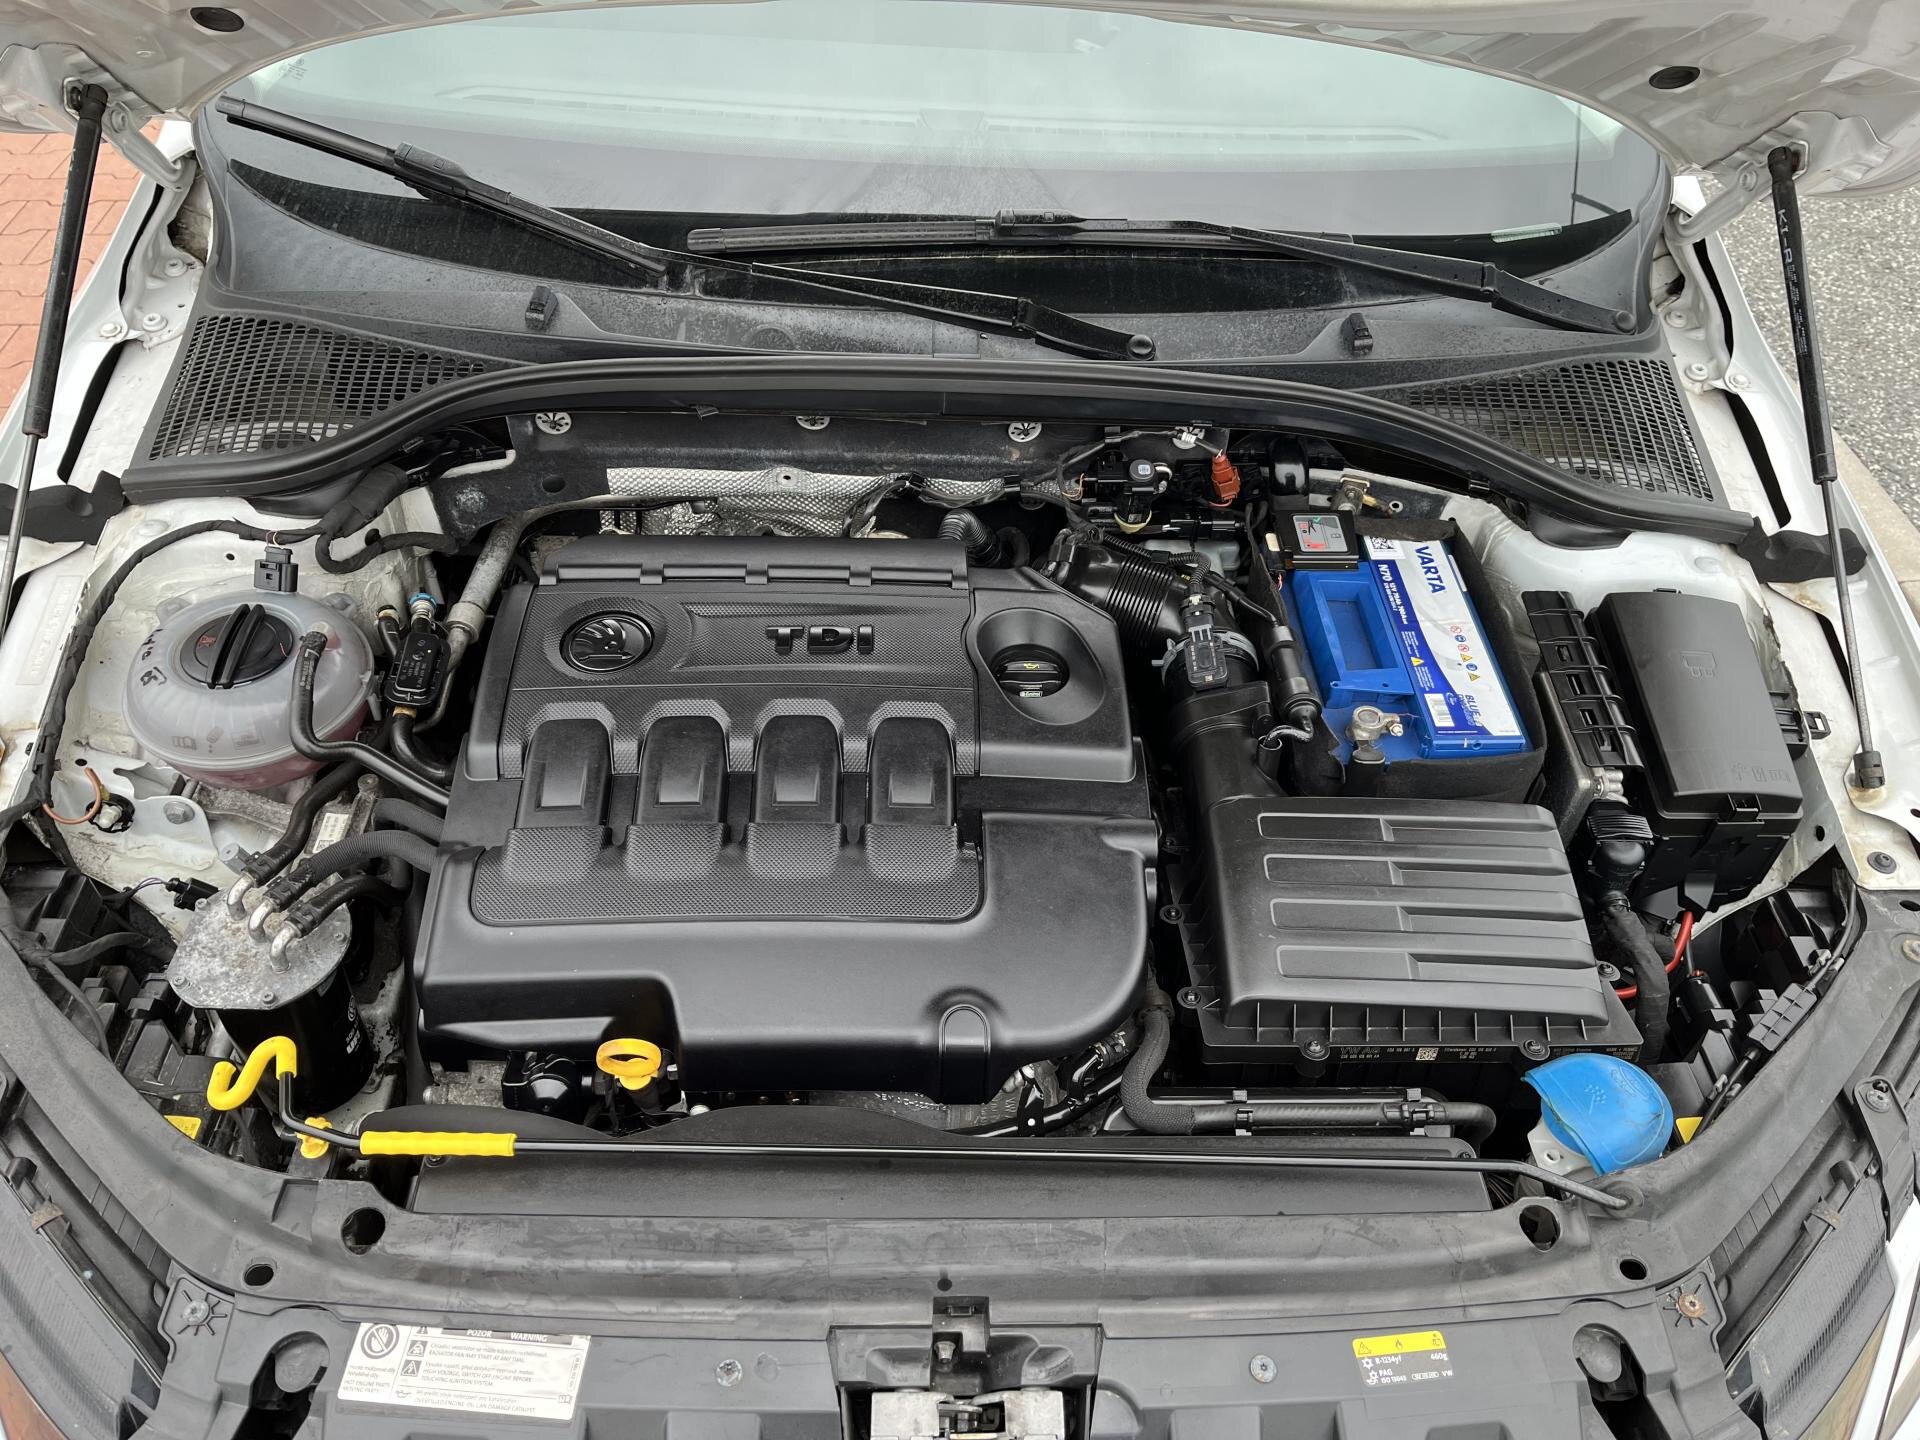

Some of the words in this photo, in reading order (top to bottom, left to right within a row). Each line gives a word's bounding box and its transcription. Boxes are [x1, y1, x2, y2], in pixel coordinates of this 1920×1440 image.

[1378, 564, 1393, 582] N70
[1415, 545, 1447, 594] VARTA
[765, 624, 875, 655] TDI
[1465, 694, 1482, 717] BLUE
[466, 1329, 493, 1339] POZOR
[510, 1332, 548, 1343] WARNING
[1375, 1355, 1402, 1365] R-1234yf
[1378, 1368, 1393, 1377] PAG
